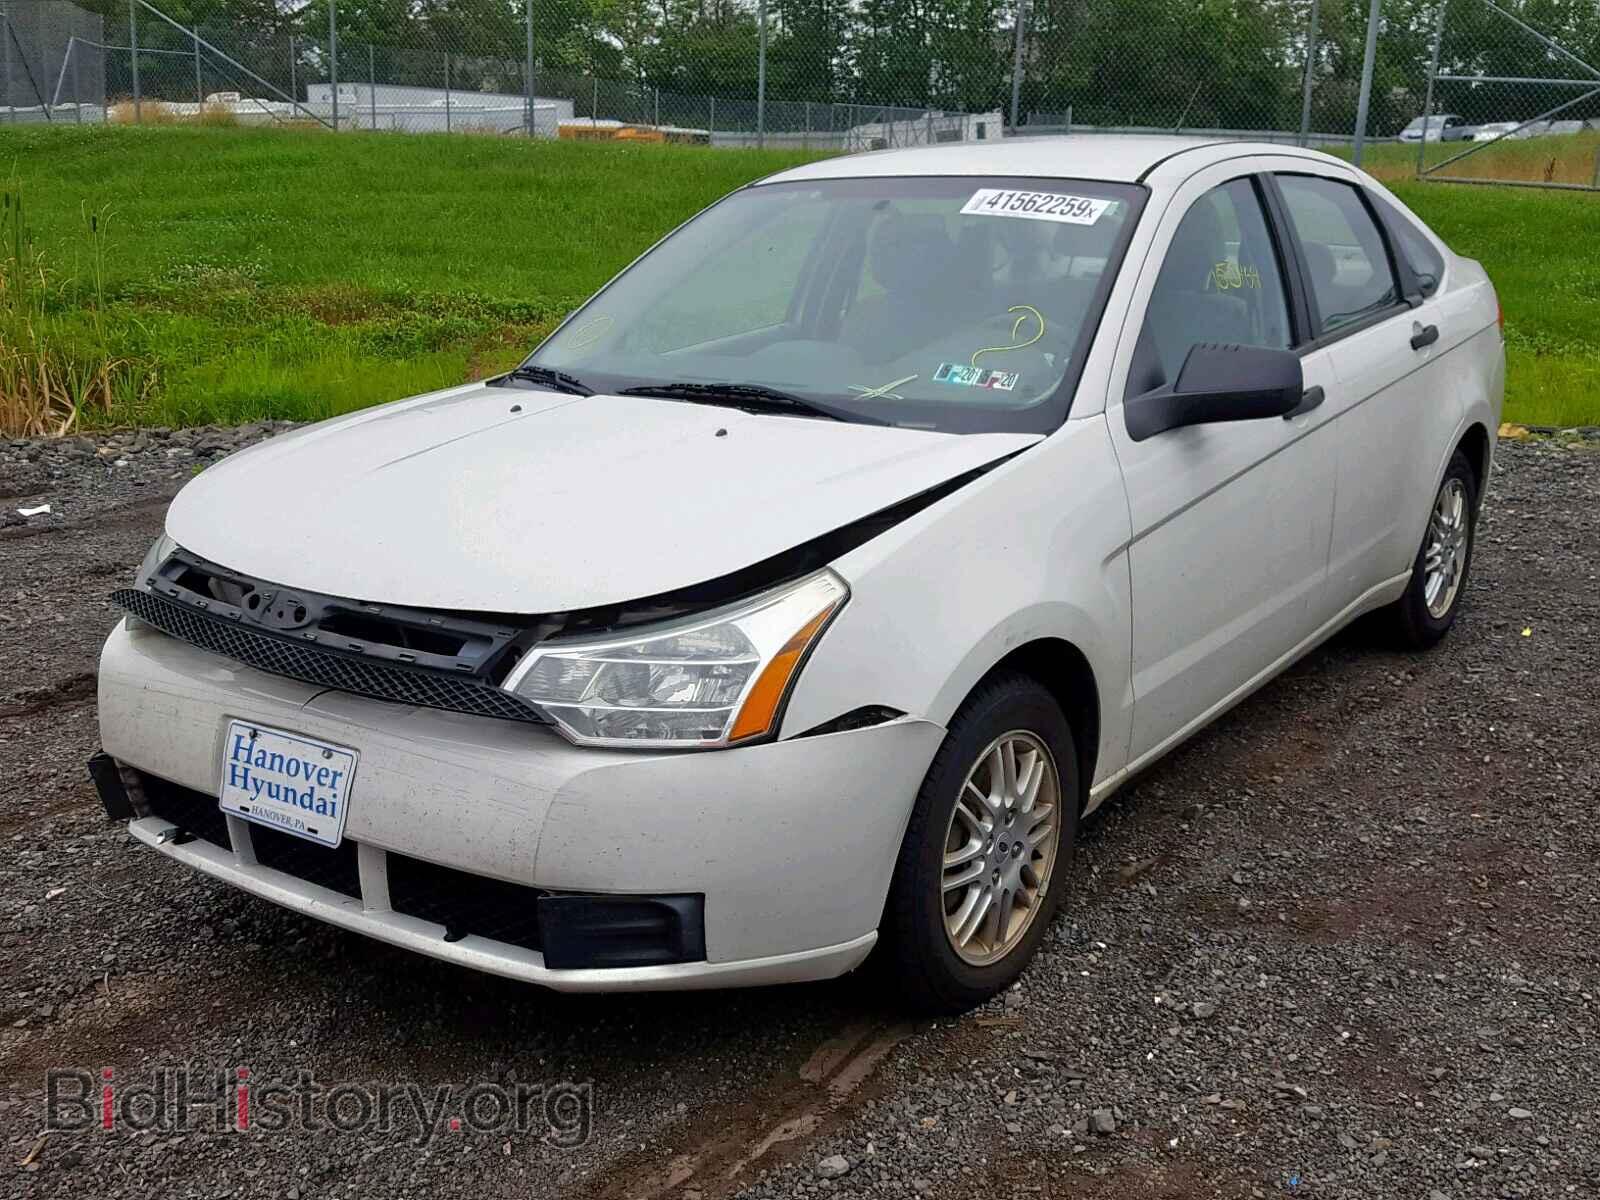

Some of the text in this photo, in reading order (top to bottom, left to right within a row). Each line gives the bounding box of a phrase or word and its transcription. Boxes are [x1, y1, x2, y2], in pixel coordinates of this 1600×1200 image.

[231, 734, 343, 790] Hanover
[229, 763, 338, 819] Hyundai
[294, 818, 305, 830] PA
